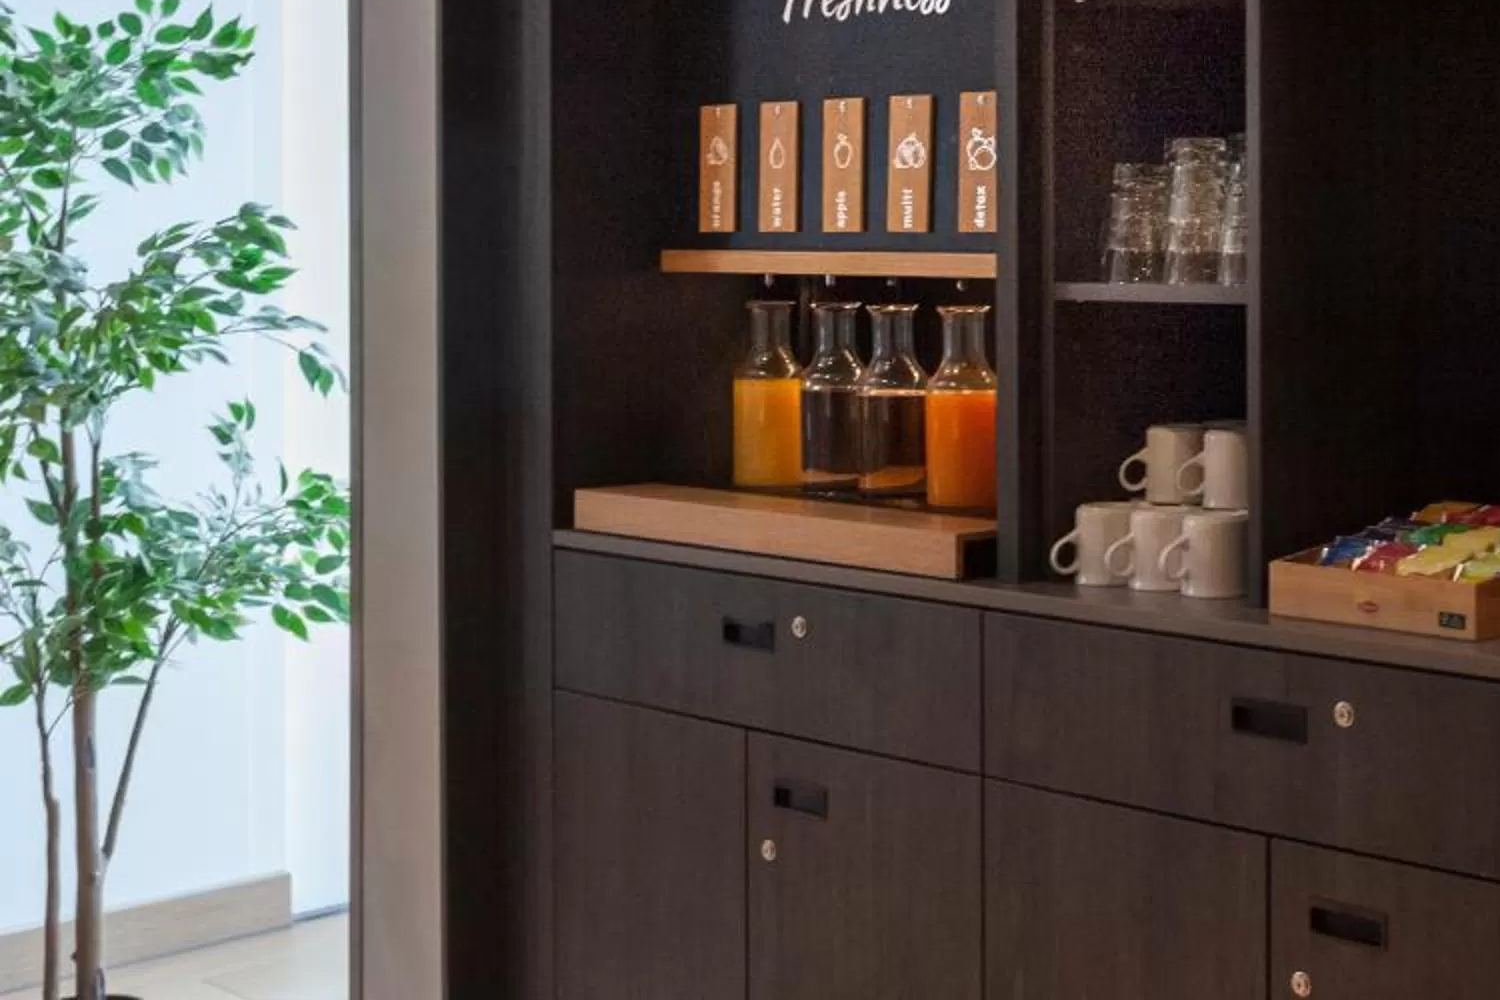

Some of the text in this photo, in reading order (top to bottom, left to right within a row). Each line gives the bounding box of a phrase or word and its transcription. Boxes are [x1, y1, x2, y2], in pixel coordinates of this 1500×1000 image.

[771, 187, 783, 228] water
[835, 190, 848, 228] apple
[901, 188, 913, 229] multi
[973, 185, 987, 228] detox
